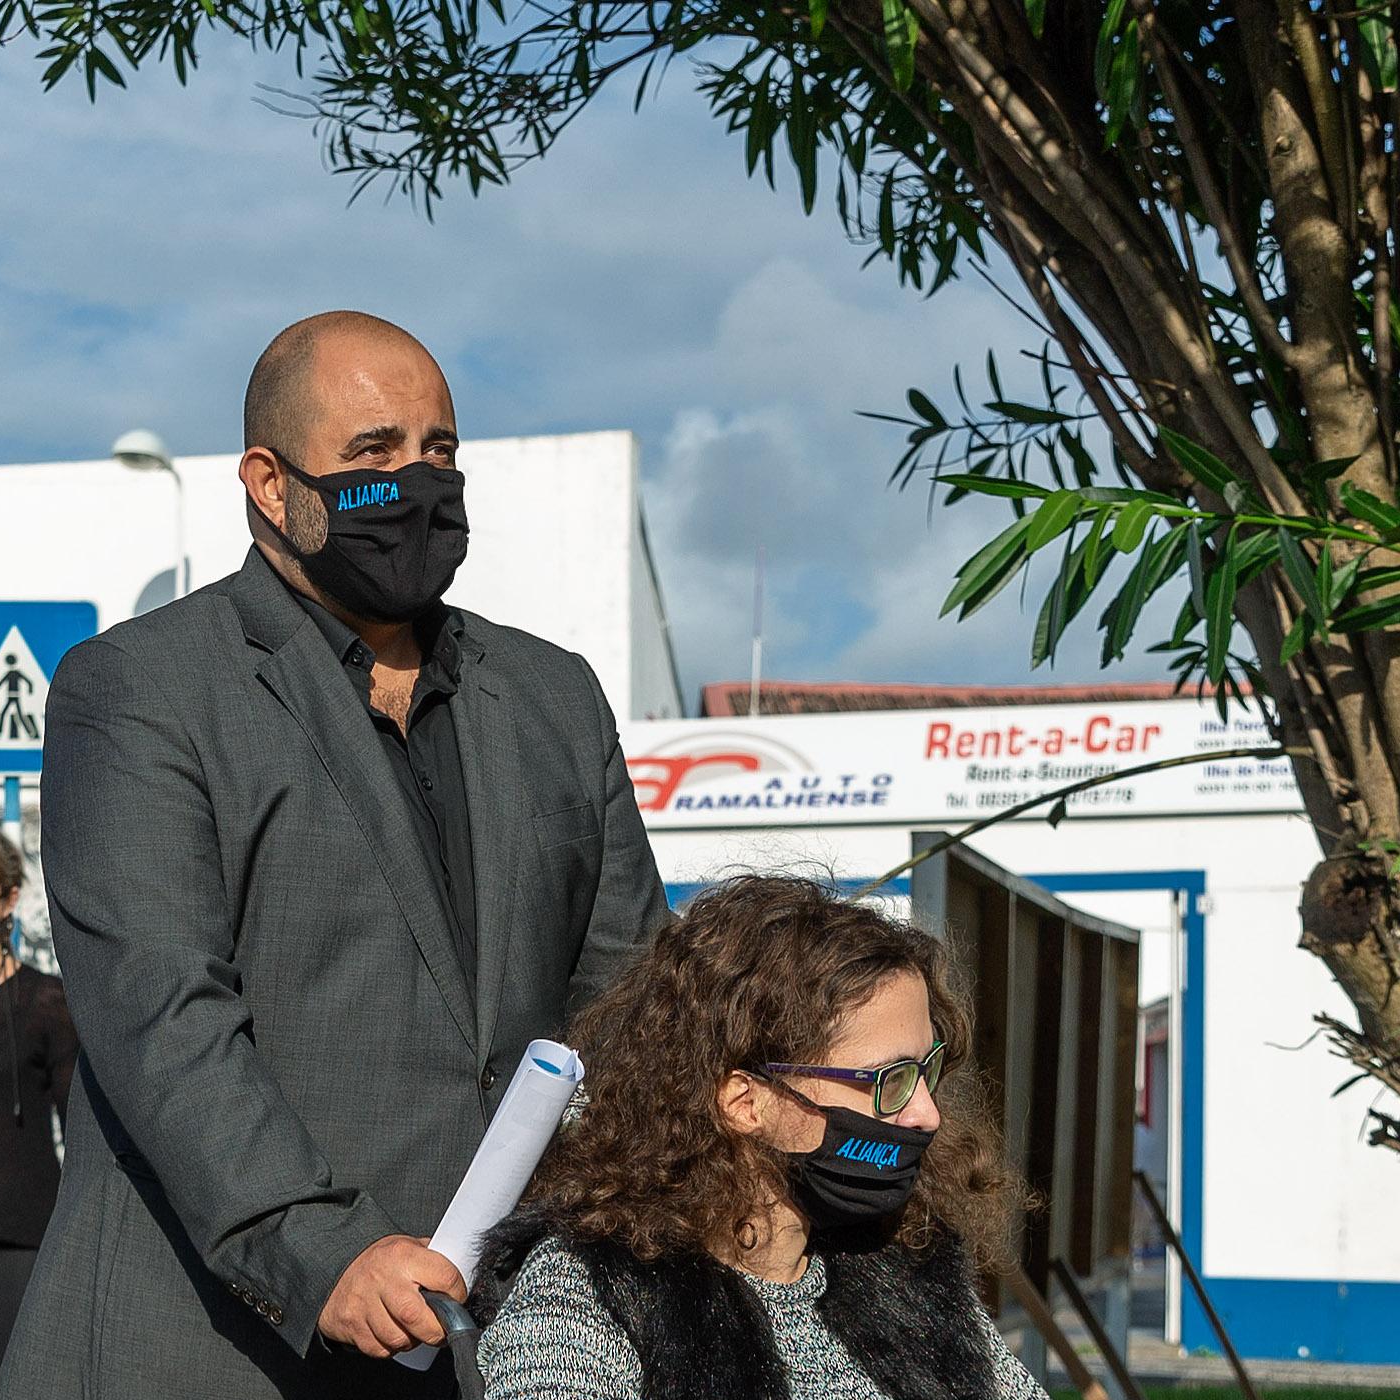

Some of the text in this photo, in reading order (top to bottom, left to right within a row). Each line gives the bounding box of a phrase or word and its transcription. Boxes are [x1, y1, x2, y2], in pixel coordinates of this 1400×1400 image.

[338, 482, 399, 511] ALIANÇA
[924, 714, 1162, 760] Rent-a-Car
[764, 773, 893, 790] AUTO
[674, 791, 890, 811] RAMALHENSE
[836, 1138, 901, 1170] ALIANÇA
